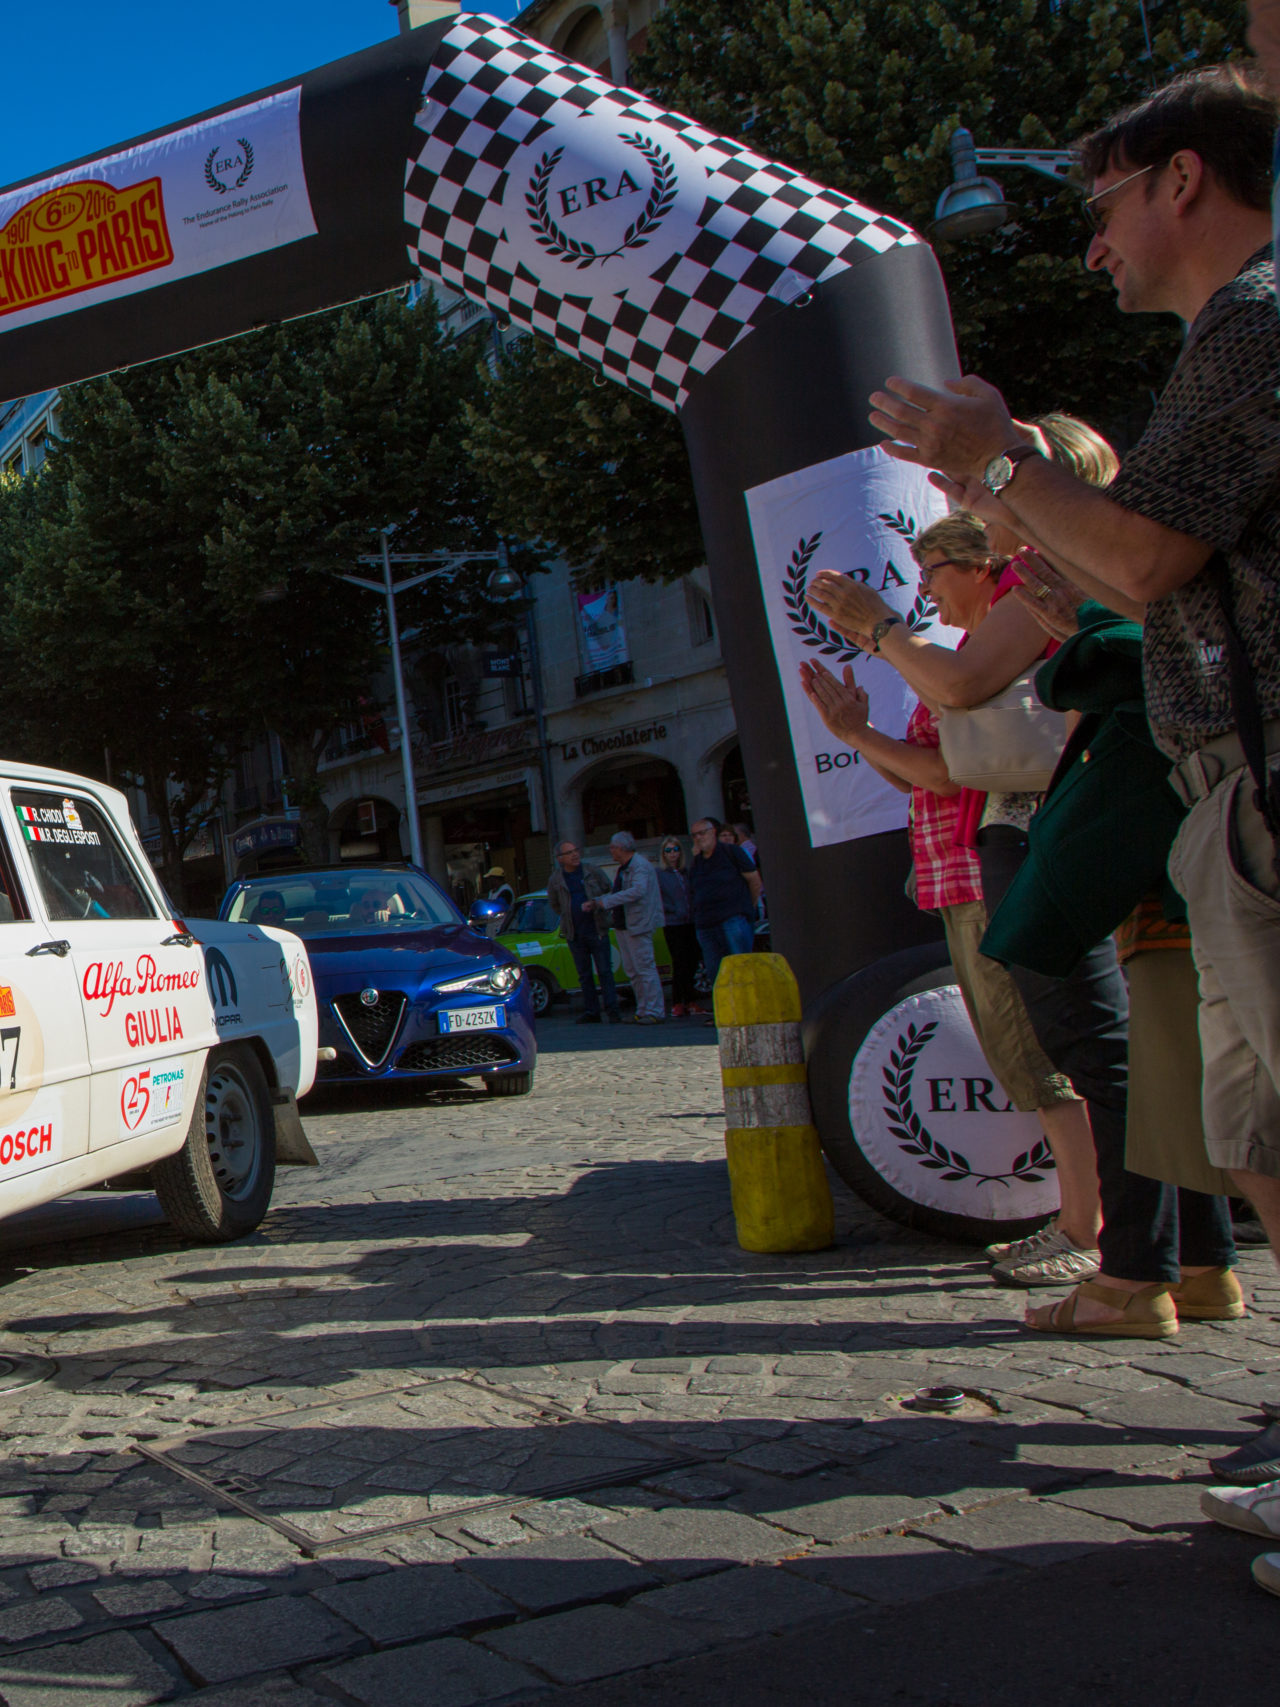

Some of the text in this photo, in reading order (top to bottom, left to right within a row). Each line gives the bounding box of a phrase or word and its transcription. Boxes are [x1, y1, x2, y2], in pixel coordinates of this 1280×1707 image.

[215, 154, 243, 174] ERA
[86, 189, 116, 222] 2016
[183, 184, 288, 225] The Endurance Rally Association
[557, 169, 643, 218] ERA
[6, 210, 32, 245] 1907
[46, 200, 76, 227] 6th
[65, 250, 79, 271] TO
[77, 188, 166, 281] PARIS
[561, 742, 578, 761] La
[581, 721, 667, 756] Chocolaterie
[83, 954, 200, 1017] Alfa Romeo
[124, 1006, 184, 1048] GIULIA
[211, 1013, 242, 1027] MOPAR
[152, 1069, 184, 1086] PETRONAS
